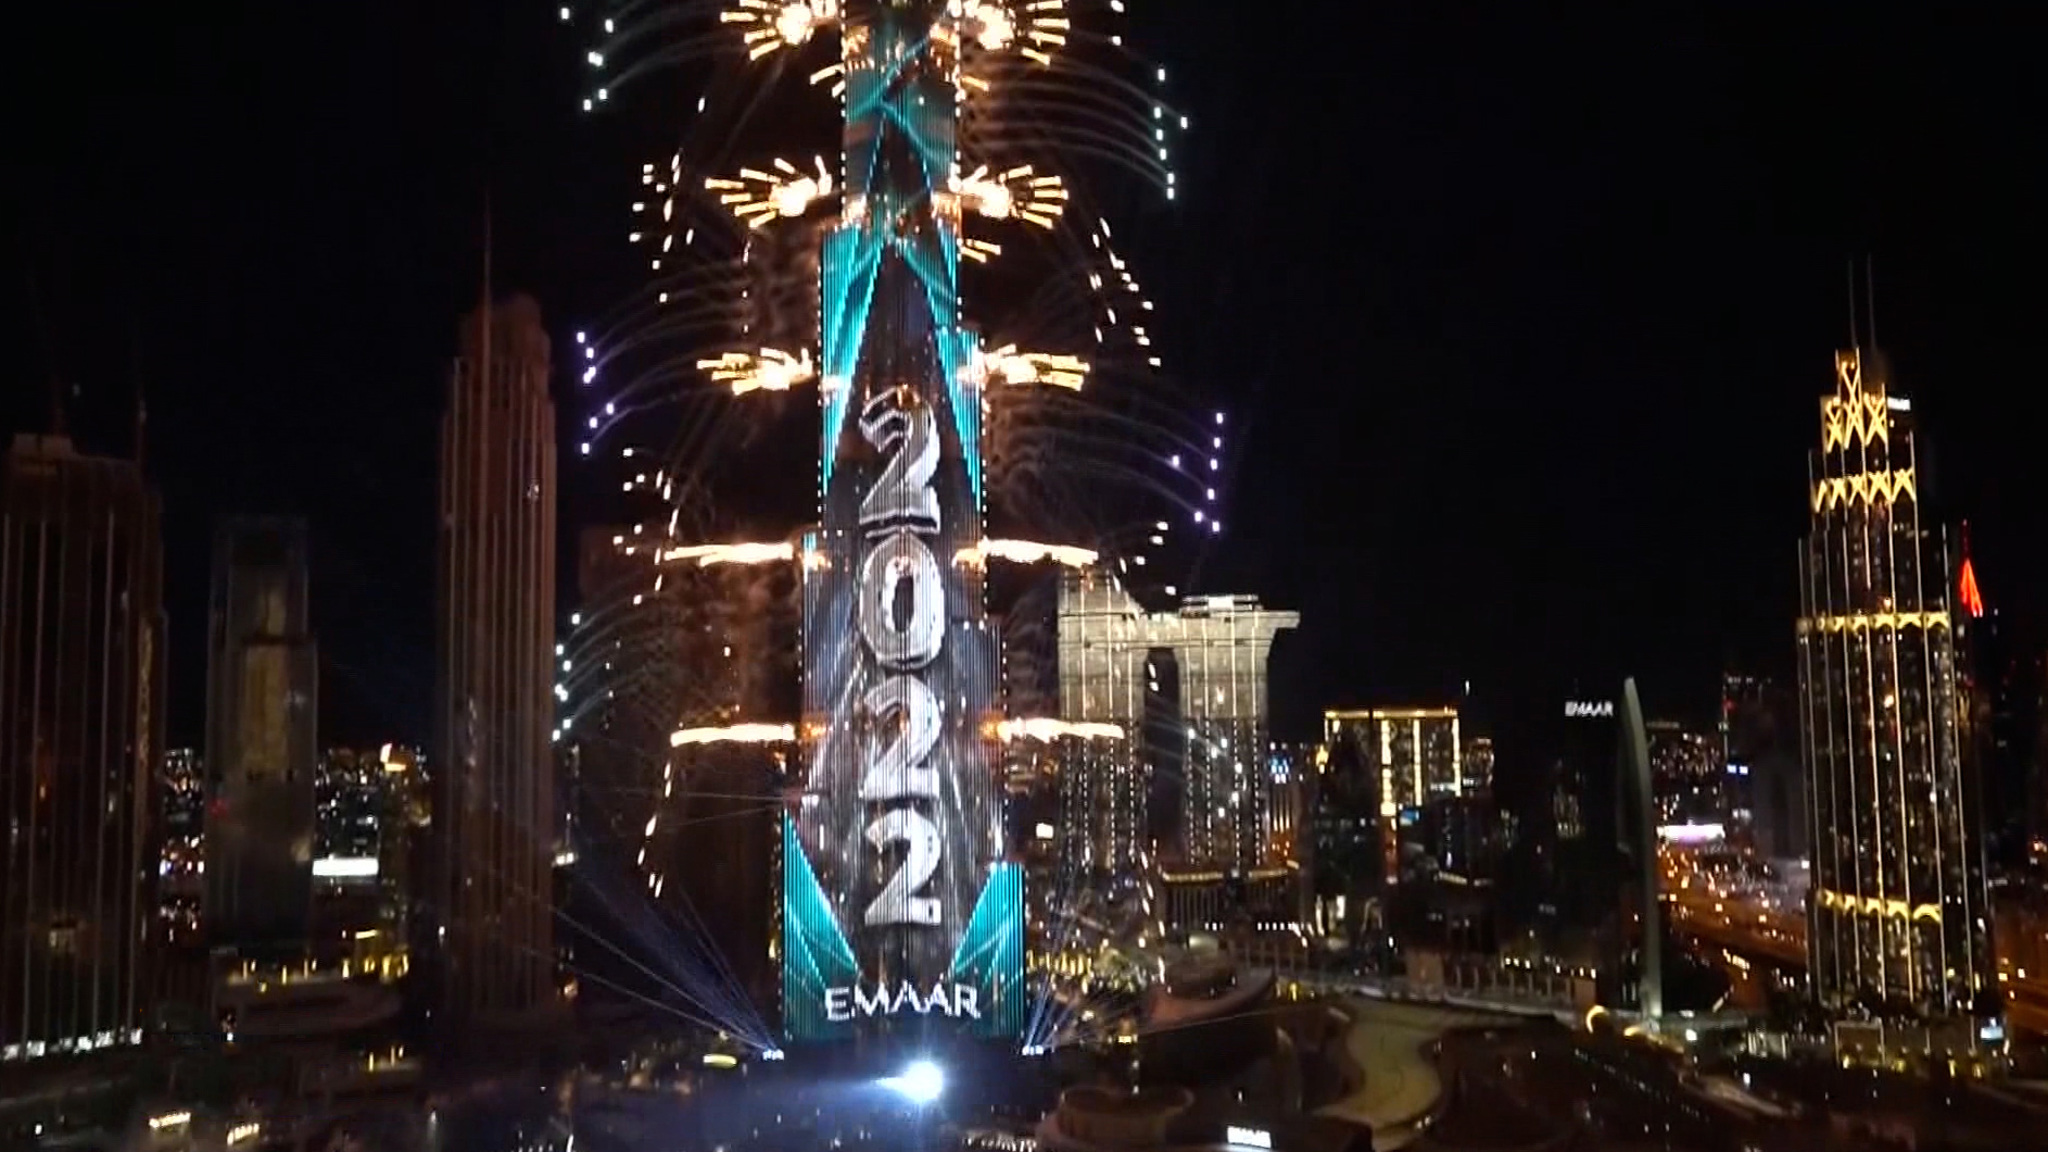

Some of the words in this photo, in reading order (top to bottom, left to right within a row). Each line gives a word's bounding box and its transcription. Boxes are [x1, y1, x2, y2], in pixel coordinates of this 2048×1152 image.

[859, 384, 945, 925] 2022
[1565, 701, 1613, 717] EMAAR
[825, 982, 981, 1021] EMAAR
